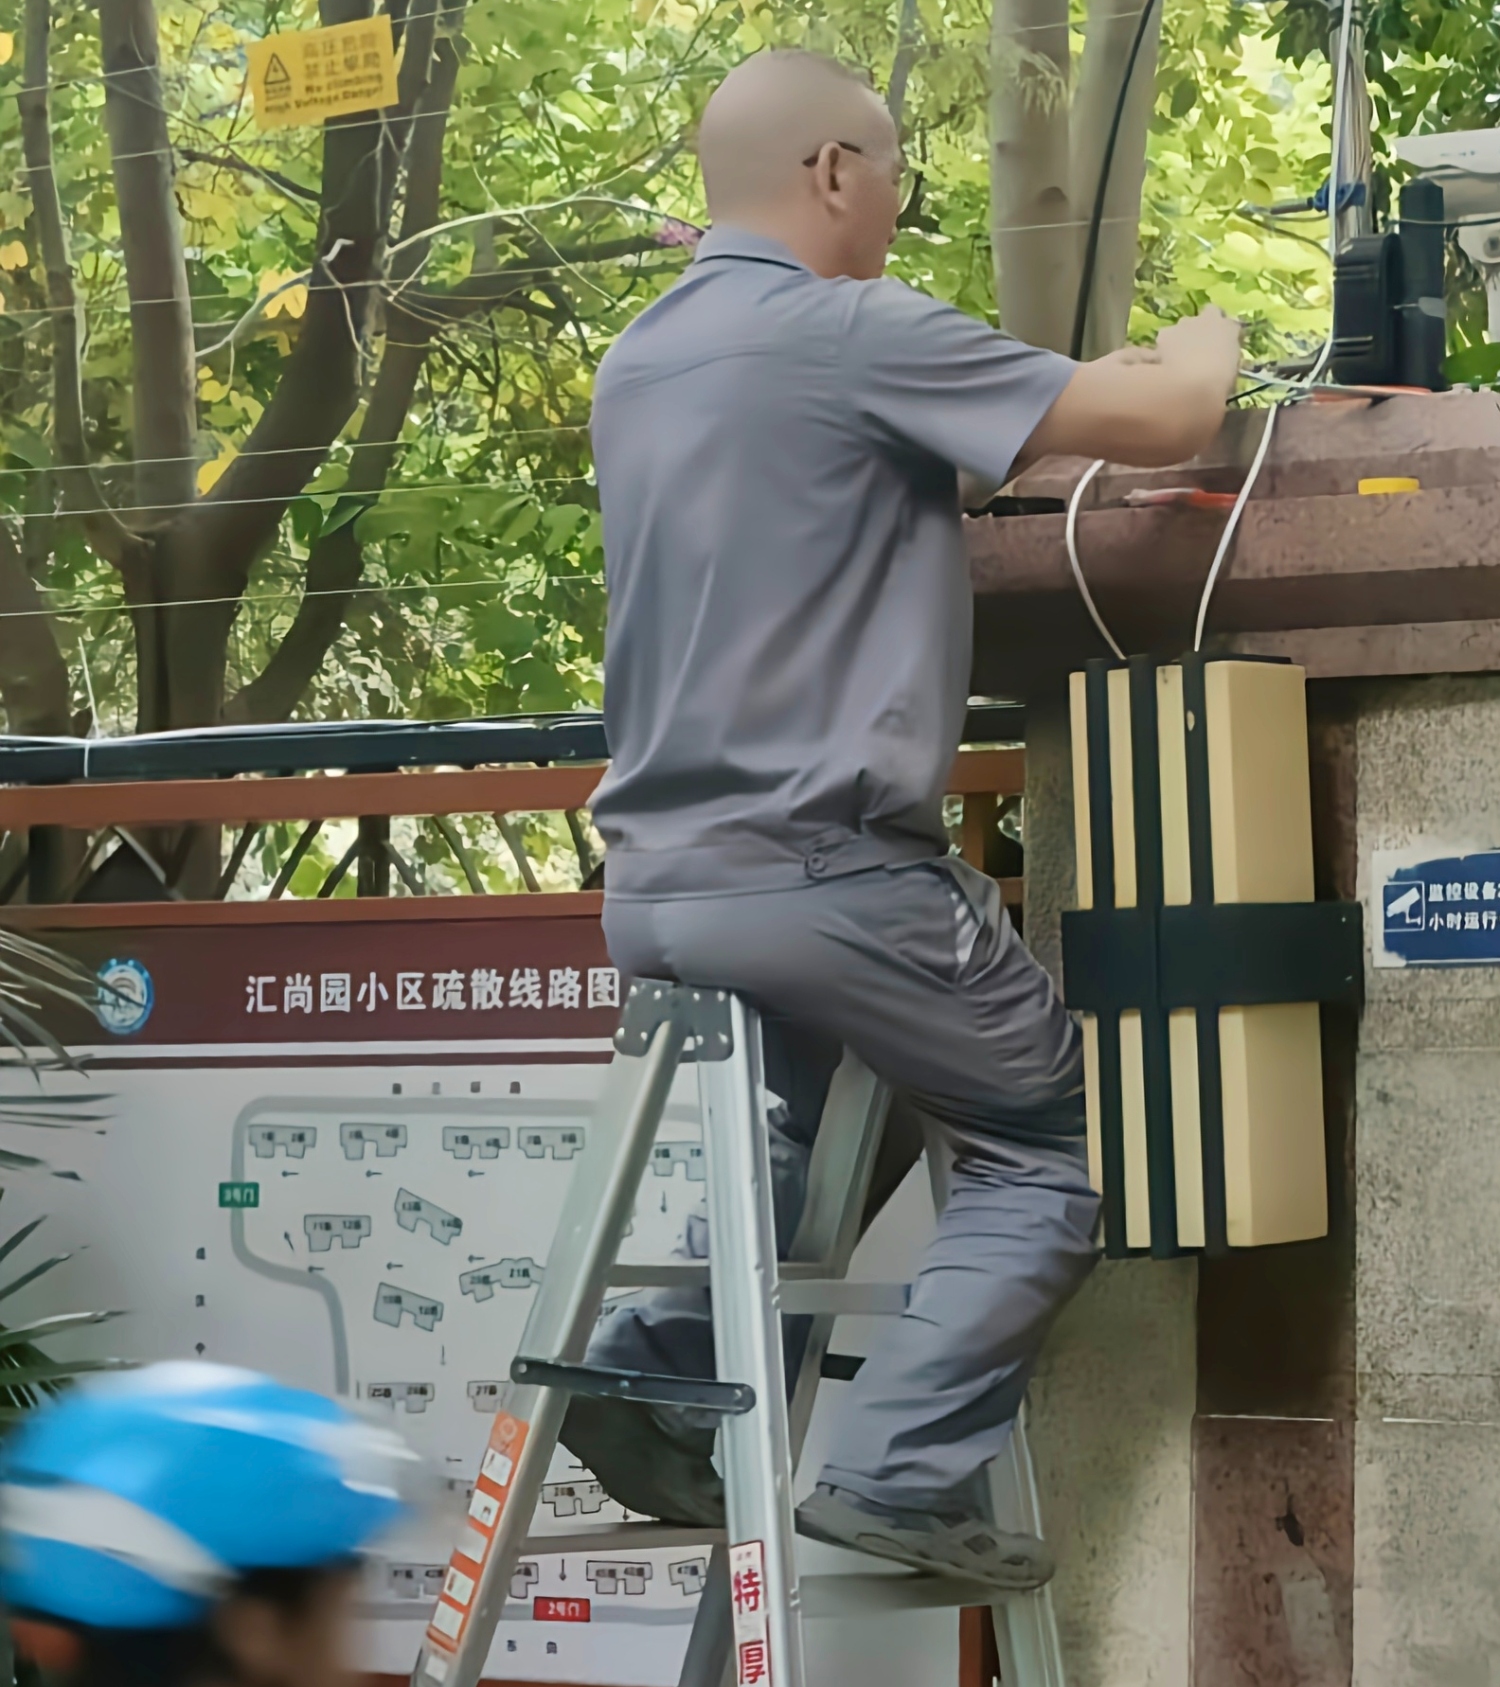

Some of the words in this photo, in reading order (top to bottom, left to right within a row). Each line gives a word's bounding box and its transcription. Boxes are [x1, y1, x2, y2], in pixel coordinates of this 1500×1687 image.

[245, 966, 620, 1014] 汇尚园小区疏散线路图
